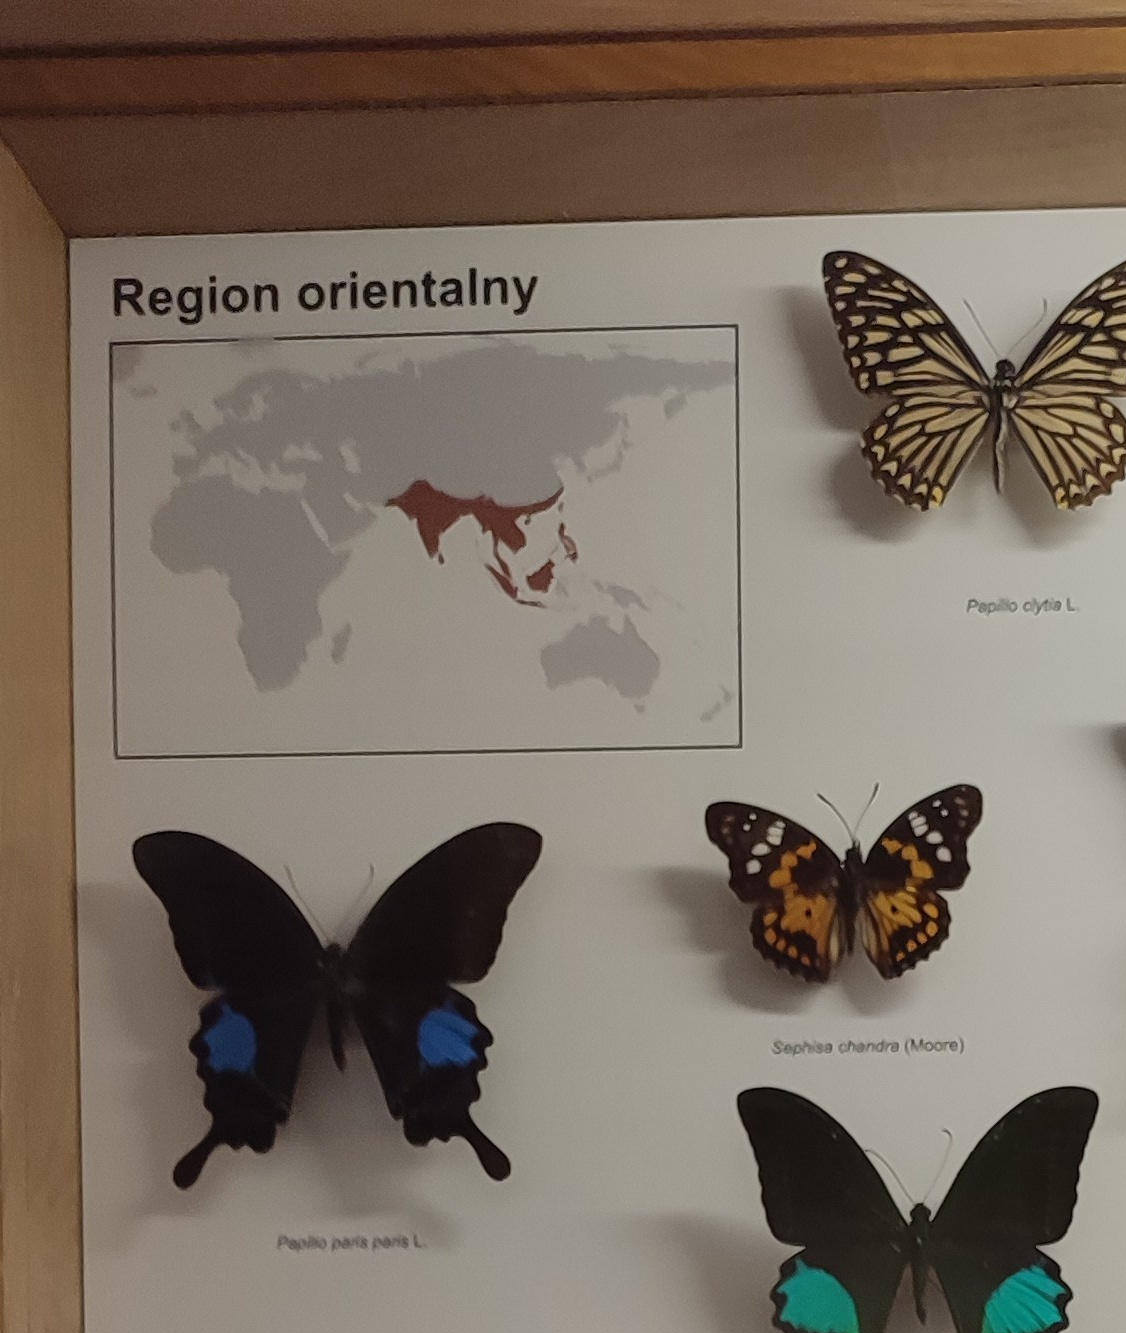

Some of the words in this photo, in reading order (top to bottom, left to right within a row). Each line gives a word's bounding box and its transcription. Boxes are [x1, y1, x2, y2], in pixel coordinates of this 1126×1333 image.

[113, 276, 279, 325] Region
[299, 268, 538, 315] orientalny
[967, 599, 1017, 615] Papilio
[1066, 598, 1079, 612] L.
[771, 1040, 832, 1057] Sephisa
[838, 1039, 899, 1053] chandra
[904, 1037, 964, 1055] (Moore)
[277, 1235, 327, 1251] Papilio
[331, 1238, 368, 1251] paris
[372, 1236, 409, 1251] paris
[414, 1235, 425, 1248] L.
